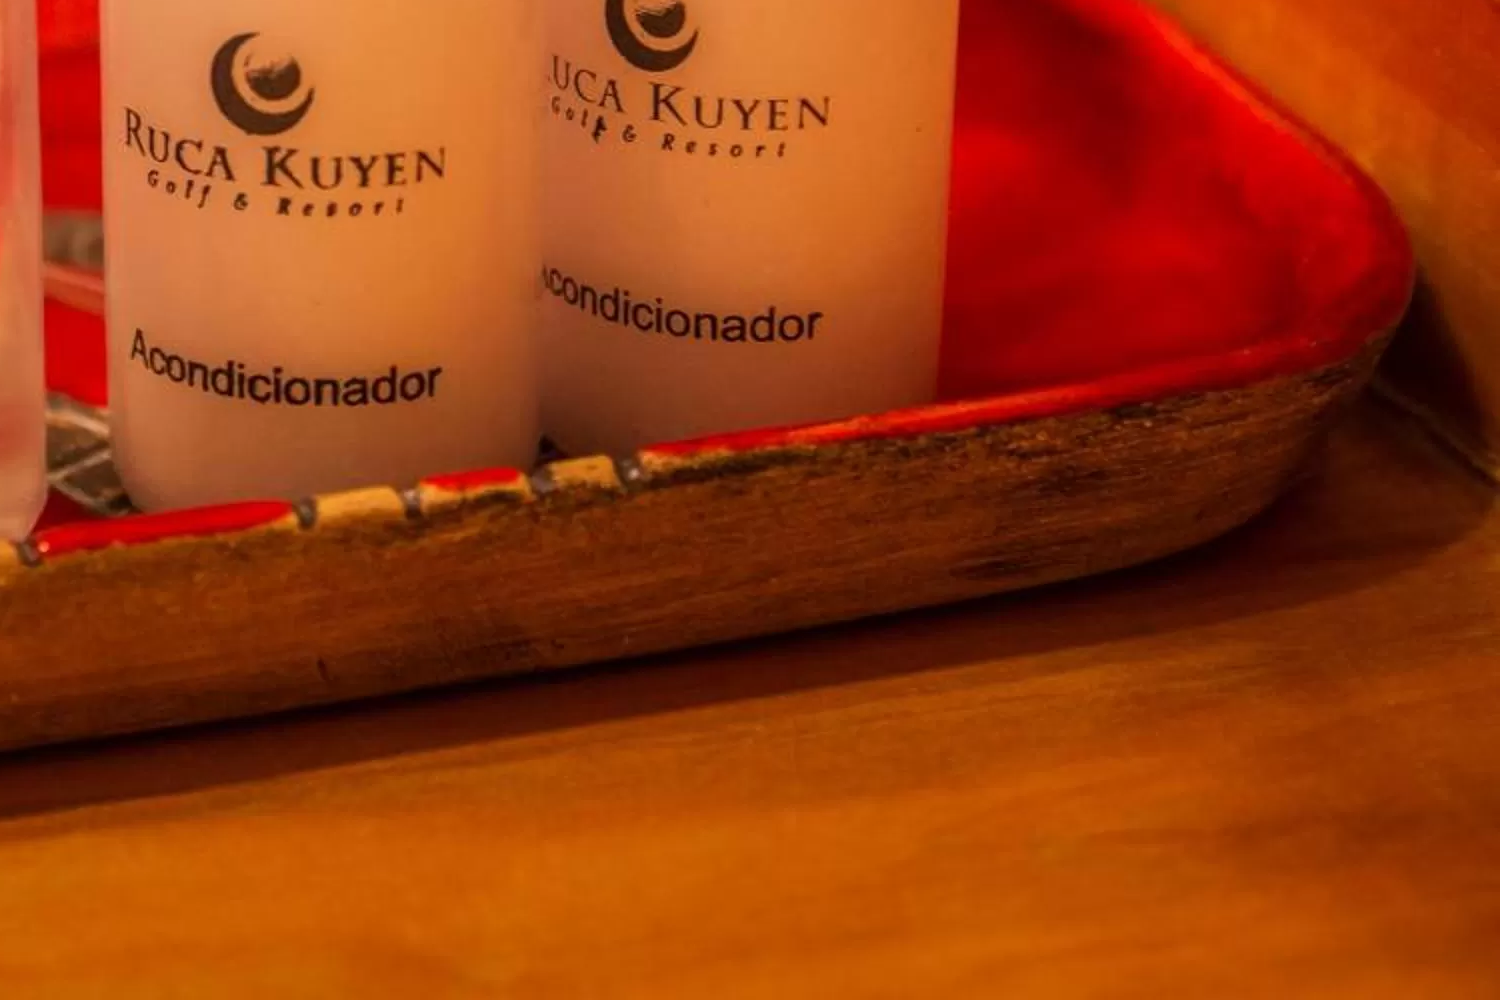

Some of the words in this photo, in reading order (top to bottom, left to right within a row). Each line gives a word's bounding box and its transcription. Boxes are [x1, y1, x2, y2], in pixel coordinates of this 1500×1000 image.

[548, 54, 624, 113] UCA
[649, 81, 831, 131] KUYEN
[125, 107, 235, 182] RUCA
[261, 146, 446, 190] KUYEN
[661, 132, 787, 158] Resort
[147, 169, 212, 209] Golf
[233, 192, 248, 211] &
[276, 197, 405, 217] Resort
[130, 328, 443, 407] Acondicionador
